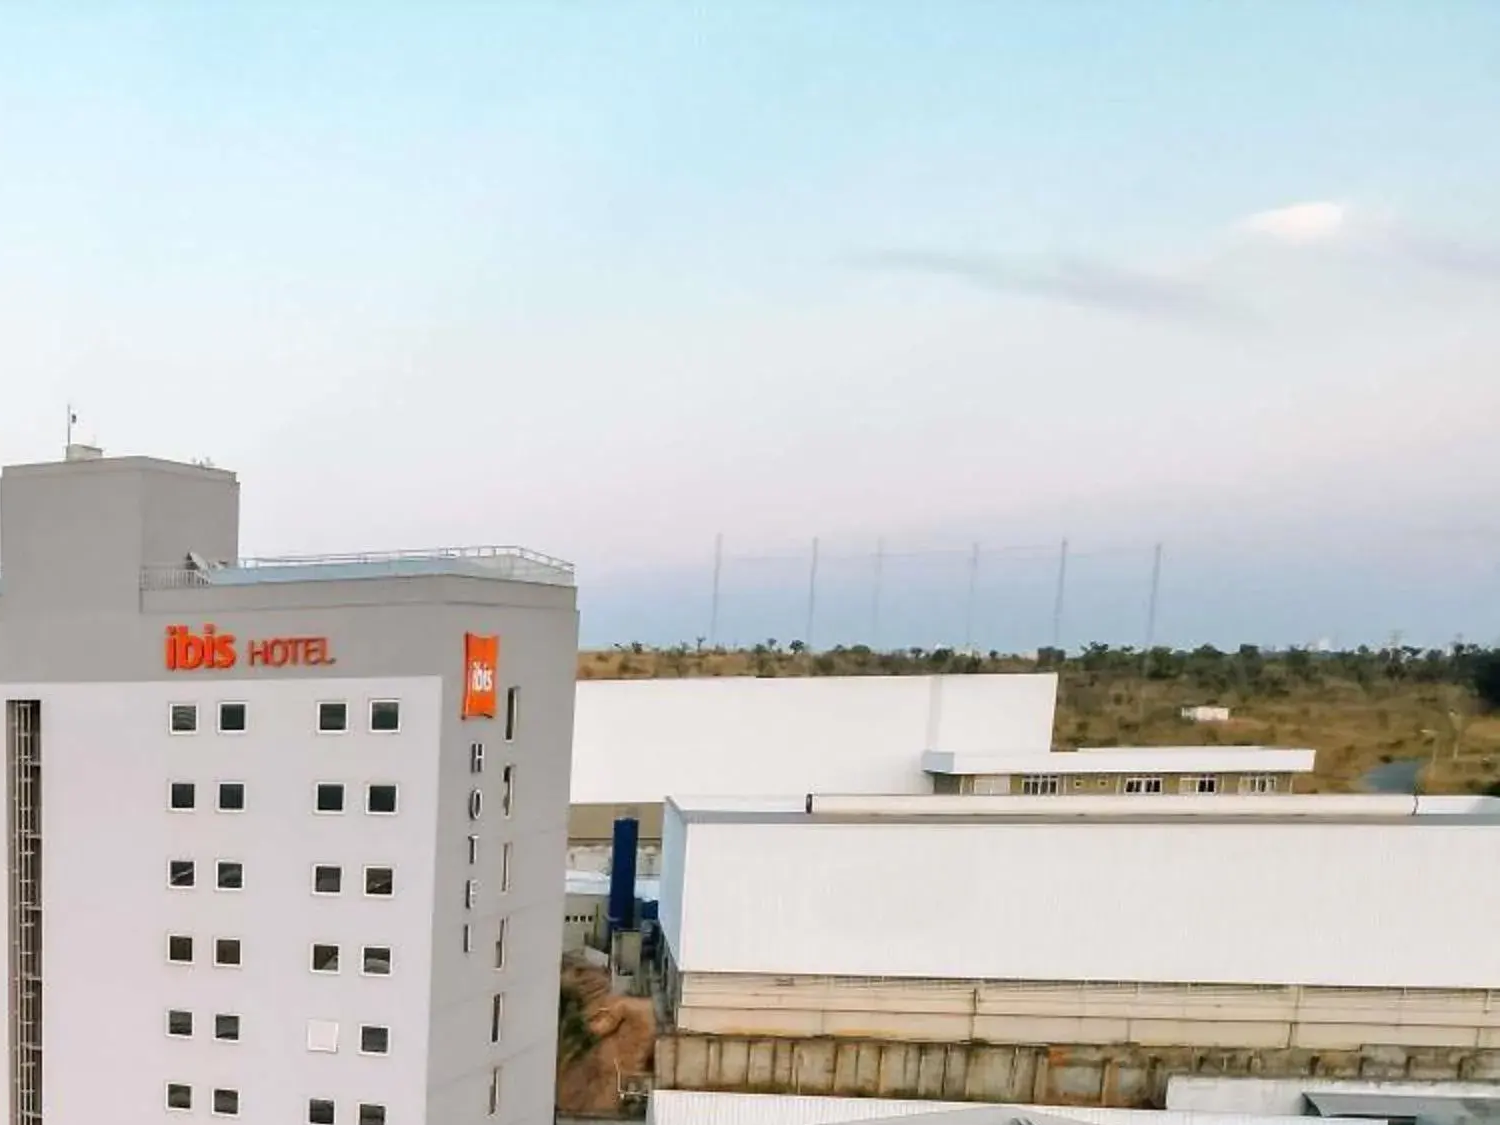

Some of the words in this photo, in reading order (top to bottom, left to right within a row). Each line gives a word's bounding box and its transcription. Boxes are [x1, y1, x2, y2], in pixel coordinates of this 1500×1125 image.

[165, 624, 237, 670] ibis
[248, 637, 334, 667] HOTEL
[471, 660, 493, 692] ibis
